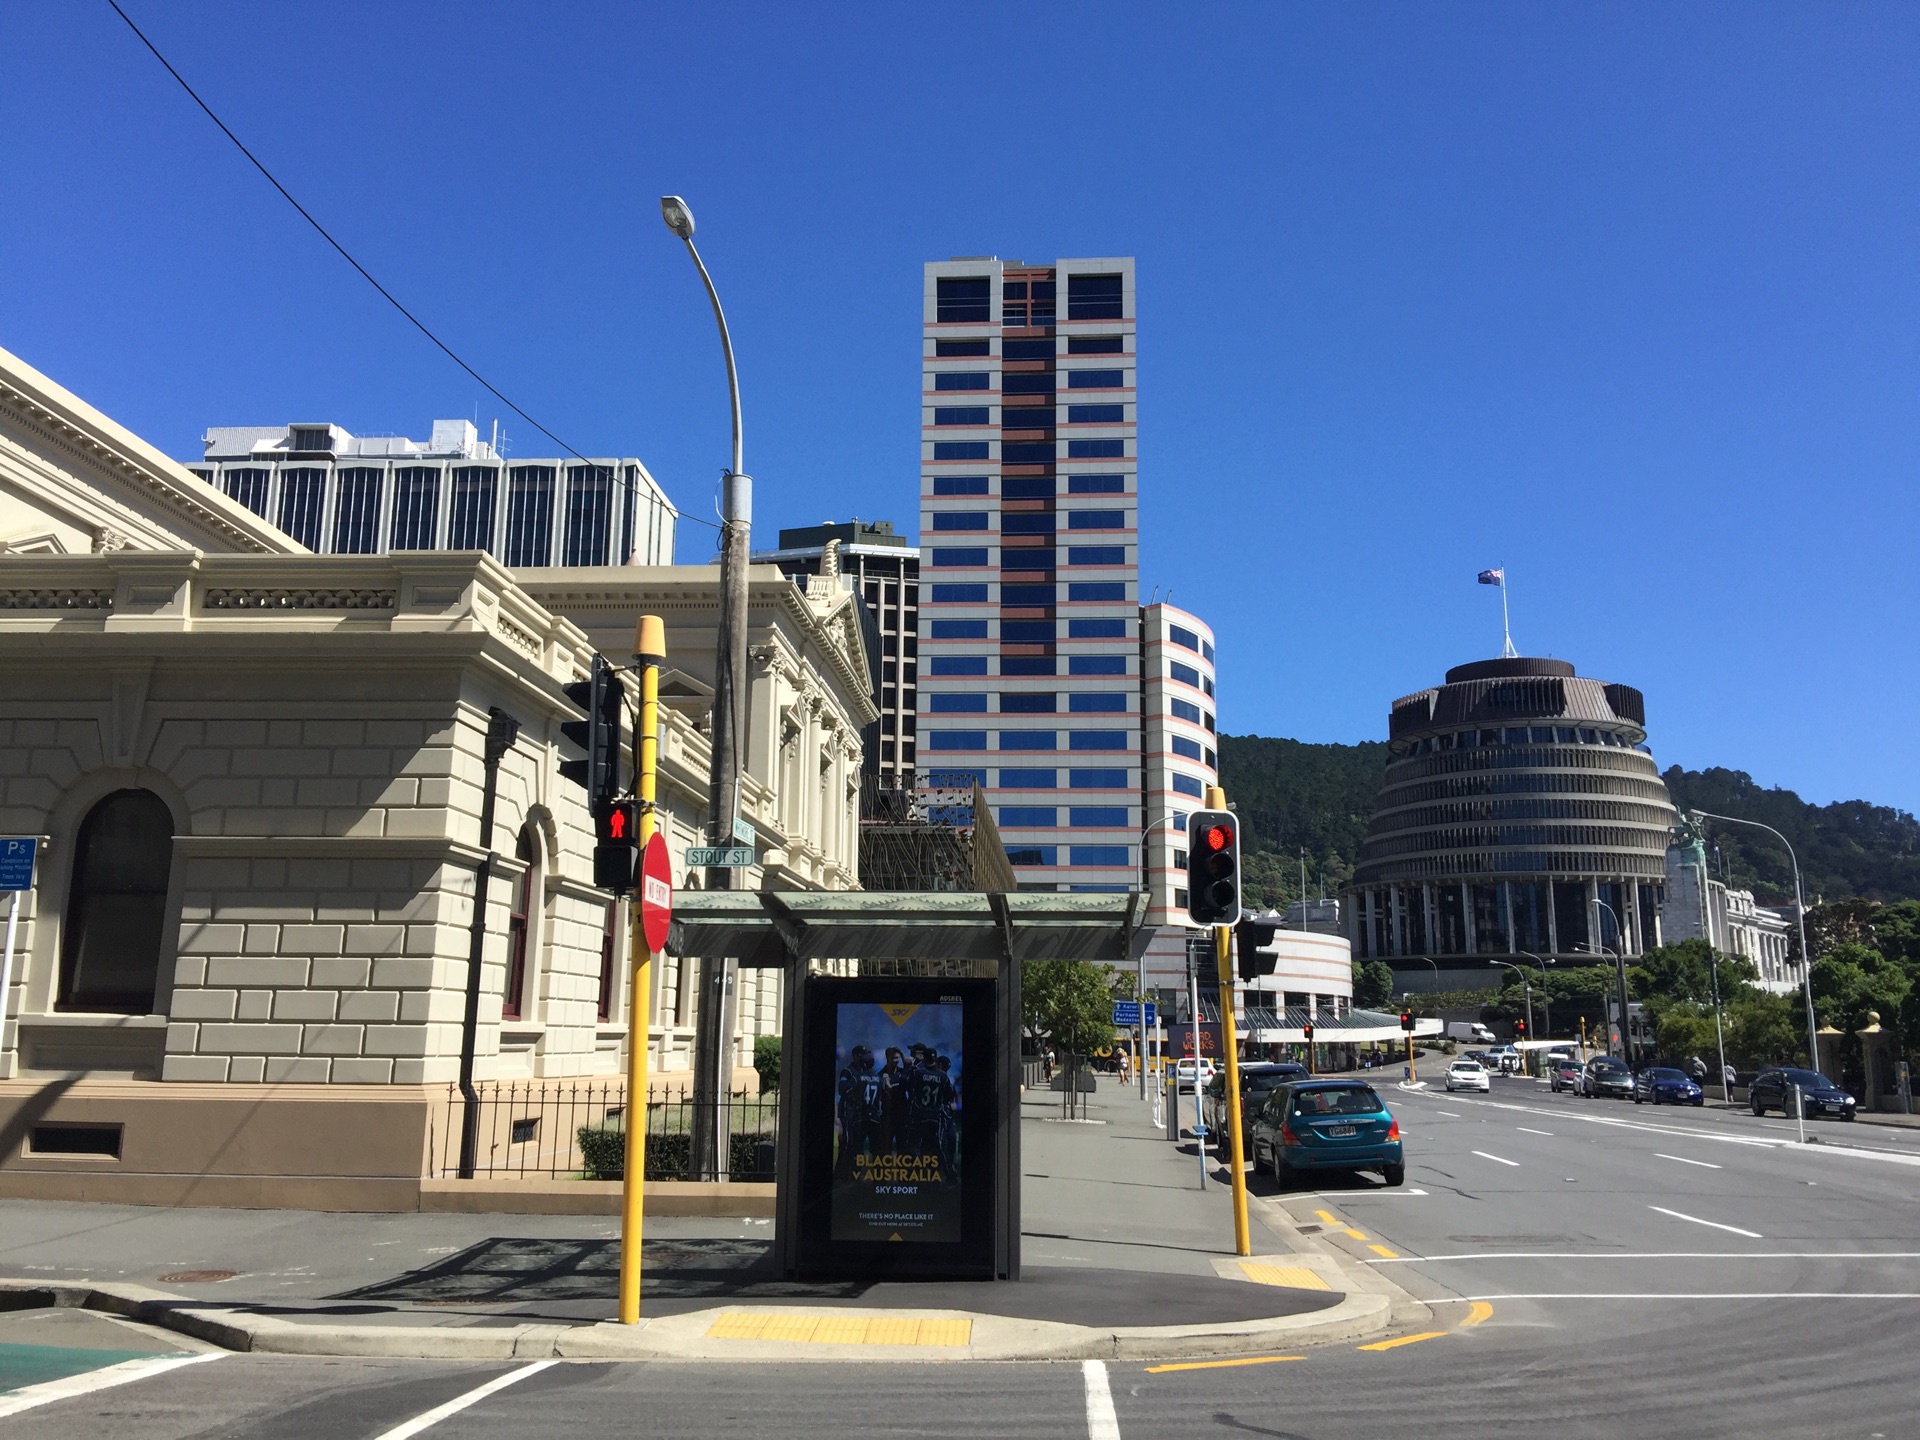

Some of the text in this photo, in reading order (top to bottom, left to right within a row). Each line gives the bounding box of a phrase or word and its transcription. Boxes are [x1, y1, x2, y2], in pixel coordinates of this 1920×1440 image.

[692, 850, 747, 864] STOUT ST
[649, 880, 667, 904] NO ENTRY
[714, 976, 733, 984] 49
[864, 1084, 878, 1105] 47
[922, 1086, 939, 1106] 31
[856, 1154, 938, 1168] BLACKCAPS
[852, 1169, 942, 1182] v AUSTRALIA
[875, 1186, 918, 1195] SKY SPORT
